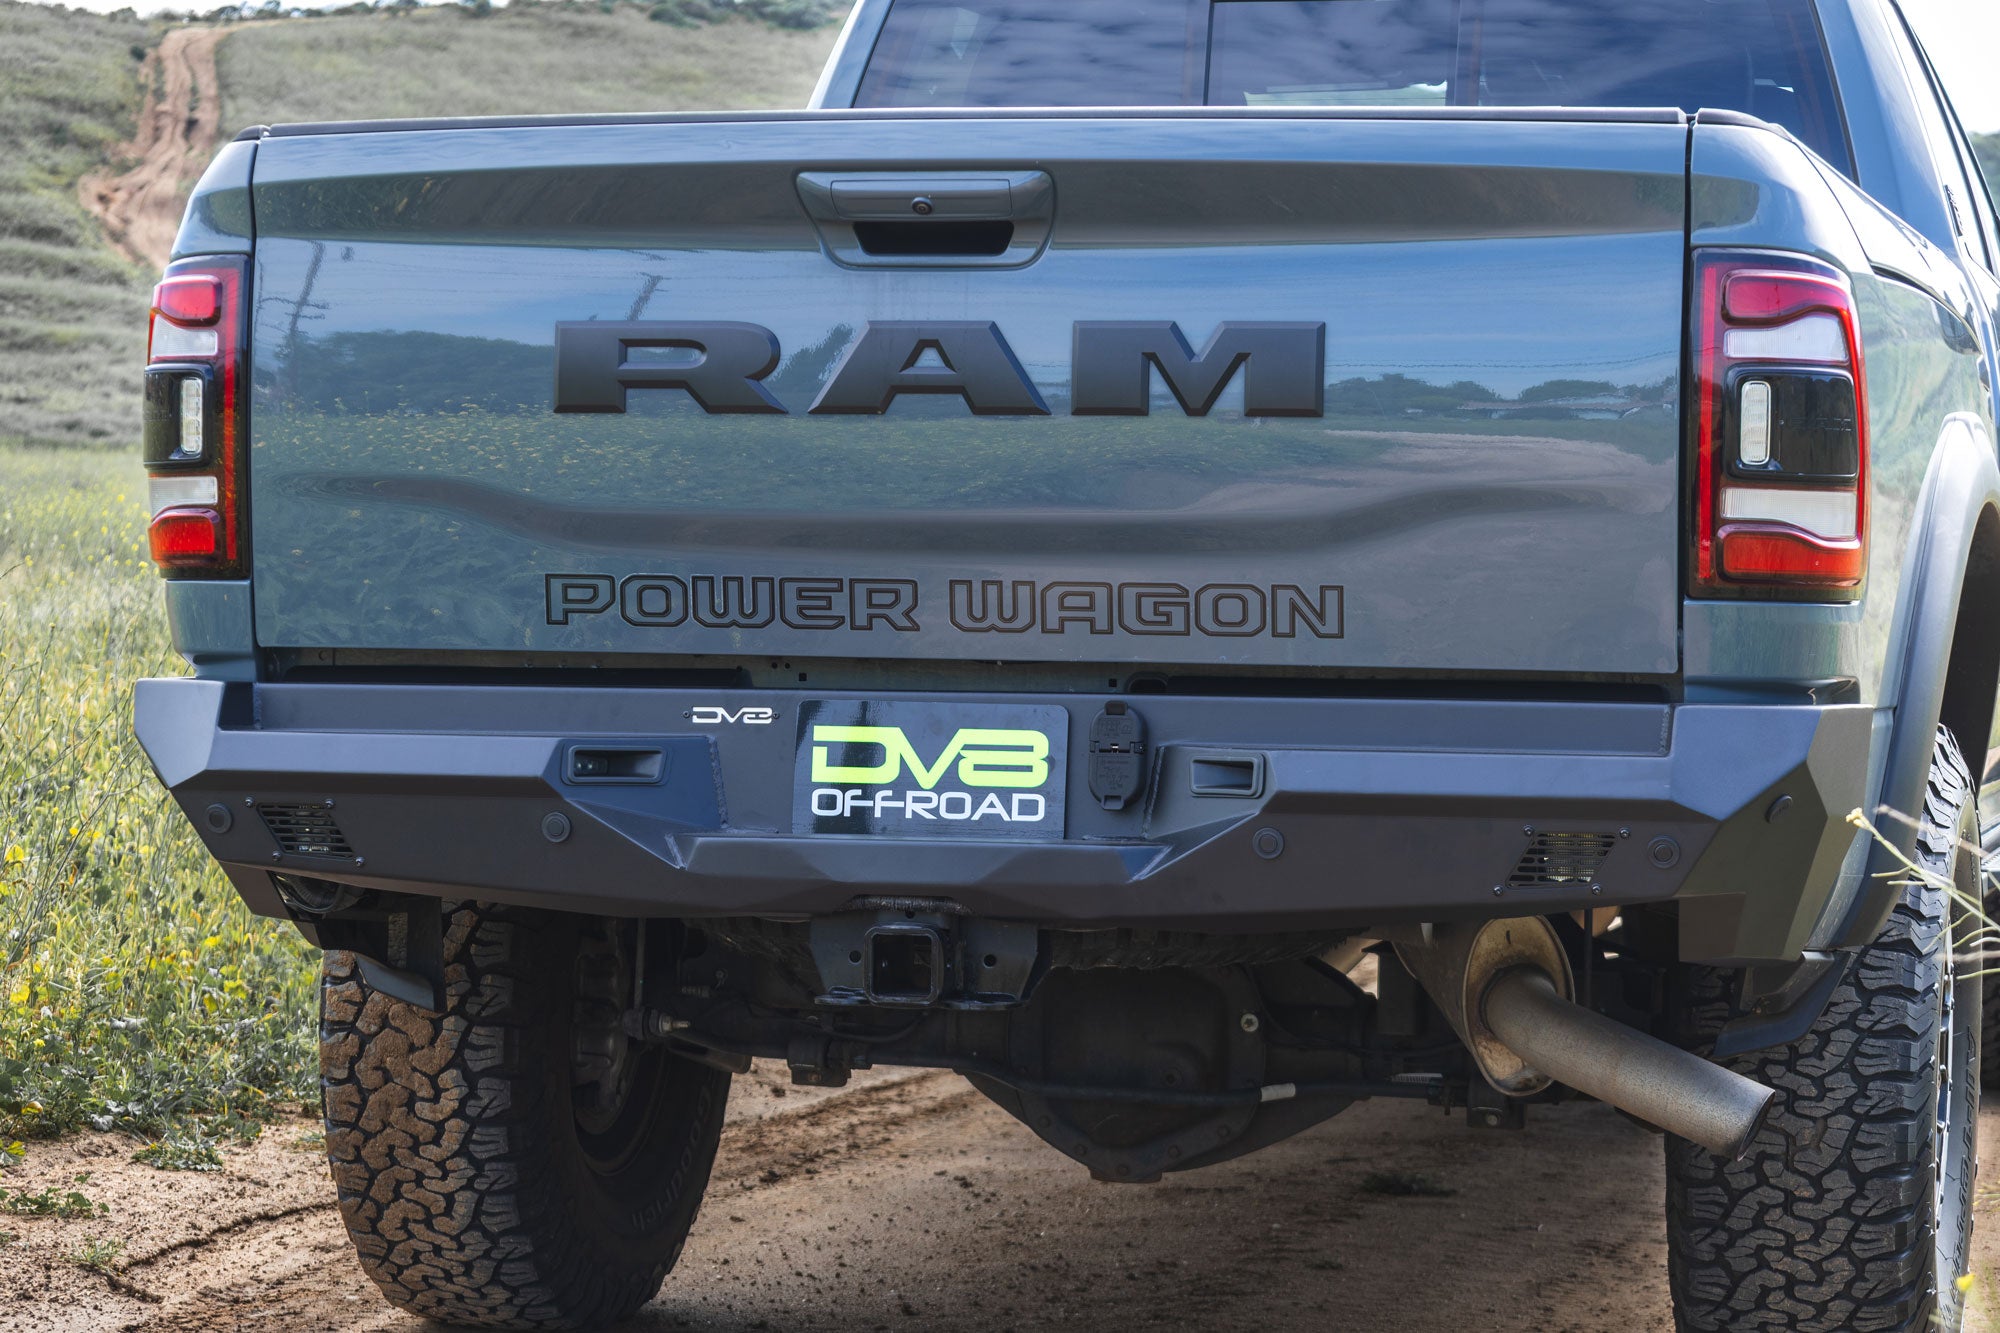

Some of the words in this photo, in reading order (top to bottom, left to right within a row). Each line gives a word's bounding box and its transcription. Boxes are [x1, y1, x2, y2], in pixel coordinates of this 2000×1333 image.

[554, 321, 1326, 416] RAM
[545, 573, 921, 633] POWER
[948, 580, 1344, 639] WAGON
[692, 707, 773, 724] DV8
[811, 725, 1049, 789] DV8
[632, 1068, 717, 1231] Goodrich
